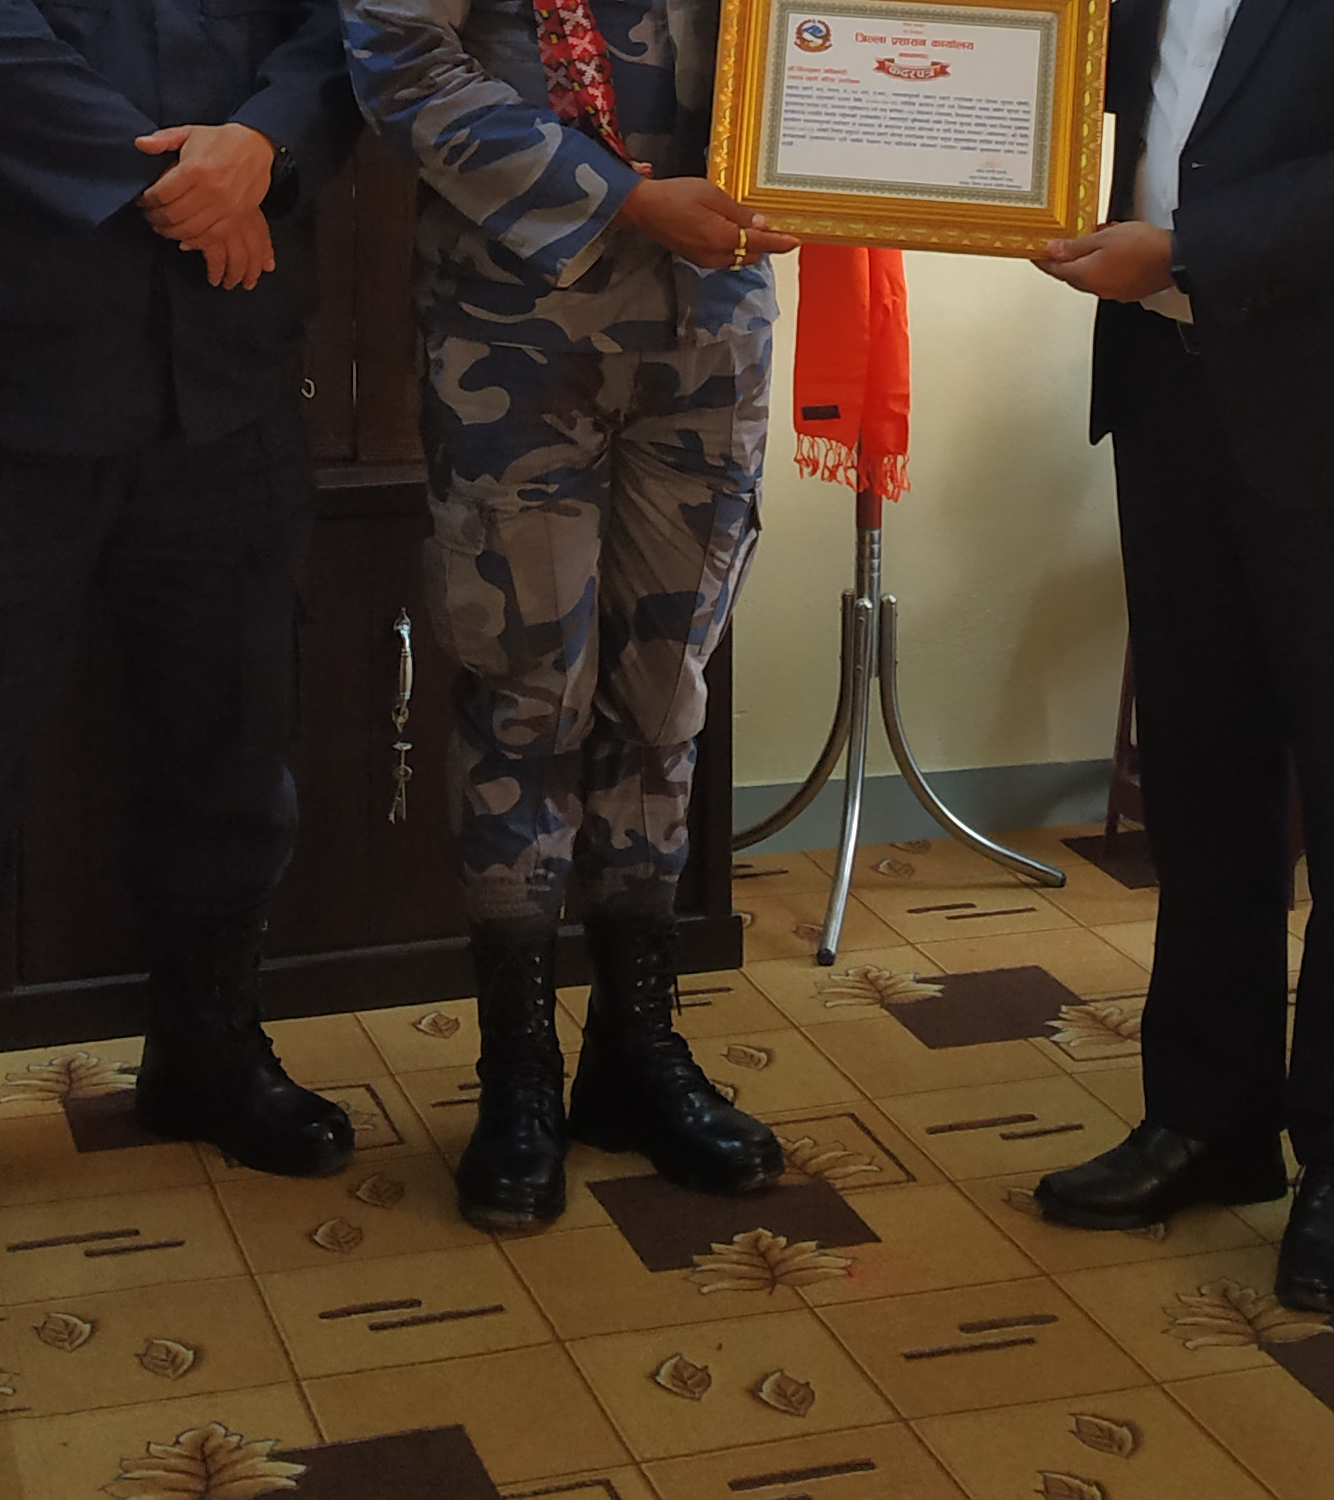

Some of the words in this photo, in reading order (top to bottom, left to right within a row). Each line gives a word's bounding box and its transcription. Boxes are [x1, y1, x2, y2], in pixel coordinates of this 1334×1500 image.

[855, 31, 887, 44] जिल्ला
[891, 35, 927, 47] प्रशासन
[931, 38, 975, 51] कार्यालय
